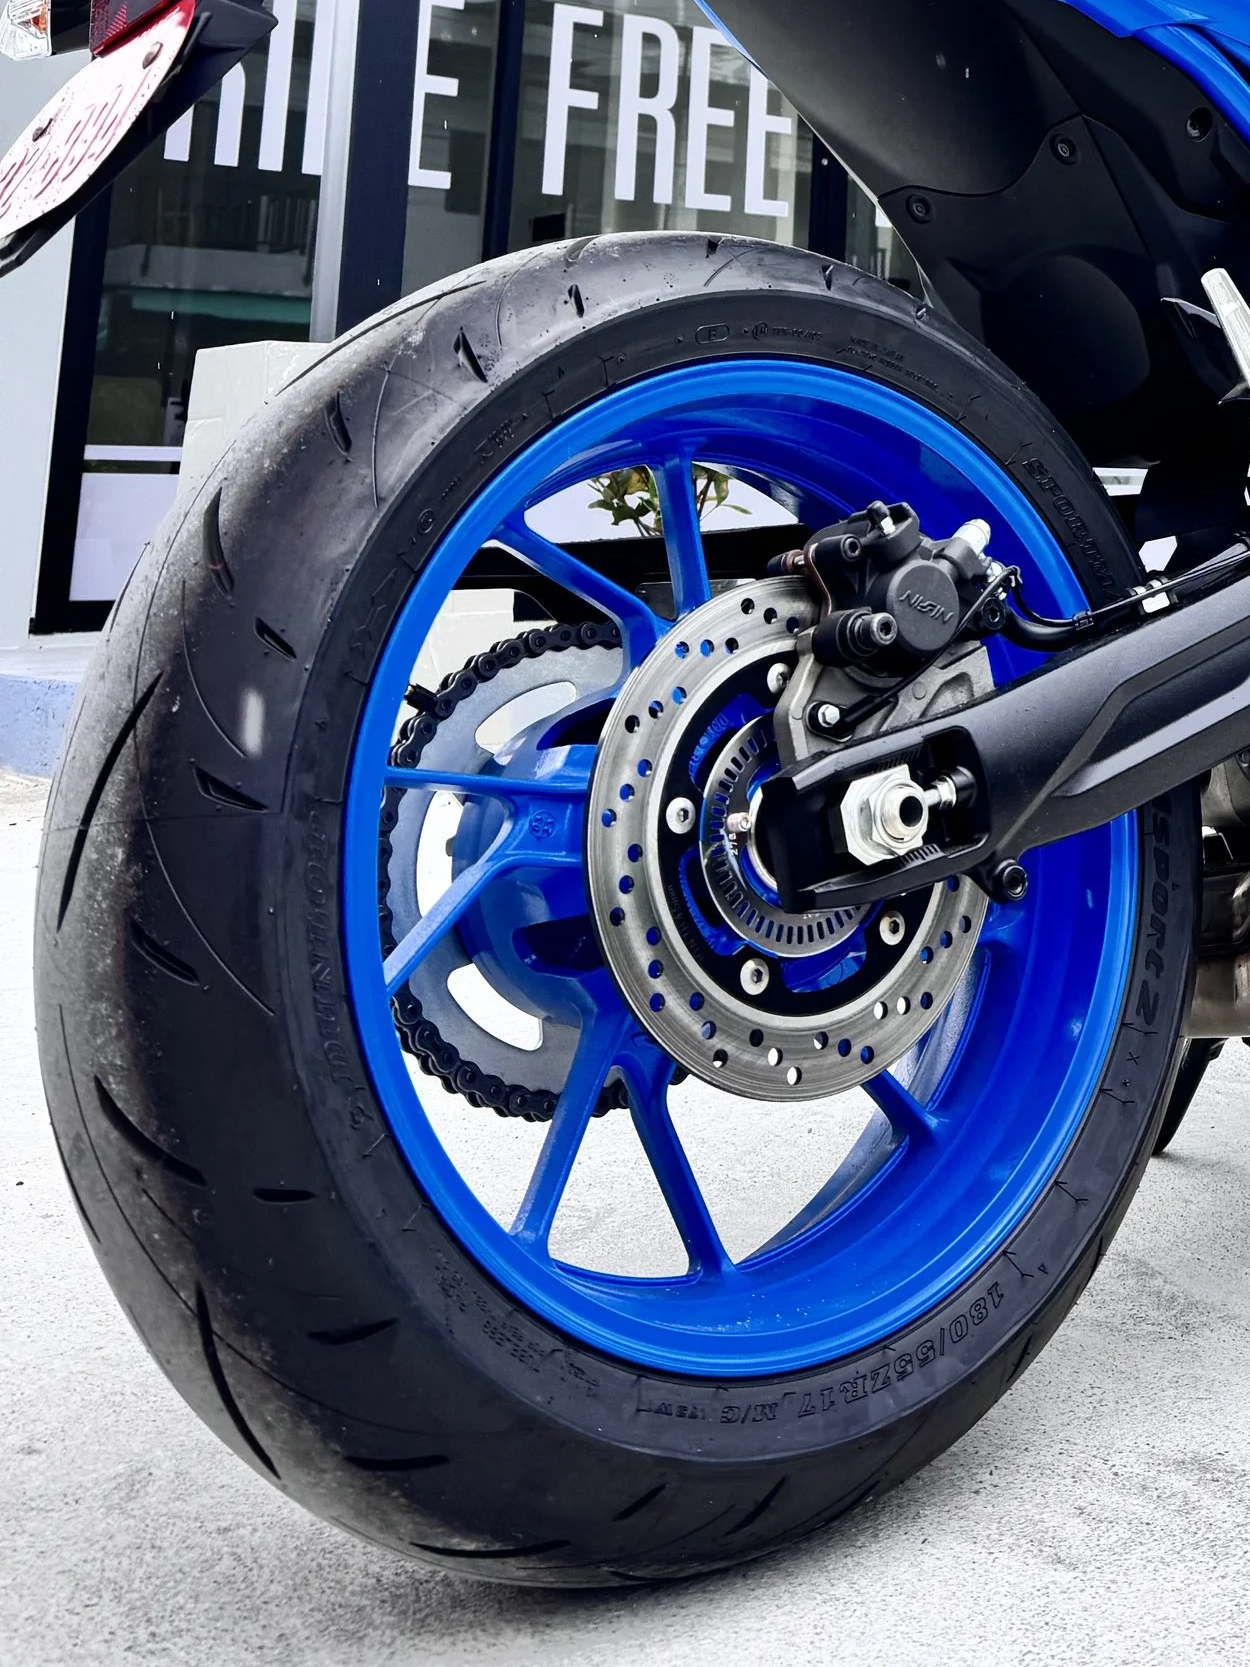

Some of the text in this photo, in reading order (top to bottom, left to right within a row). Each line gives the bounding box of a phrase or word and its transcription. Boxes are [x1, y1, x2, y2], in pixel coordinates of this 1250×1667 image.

[541, 2, 793, 218] FREE
[718, 1400, 781, 1425] M/C
[796, 1279, 1005, 1419] 180/55ZR17
